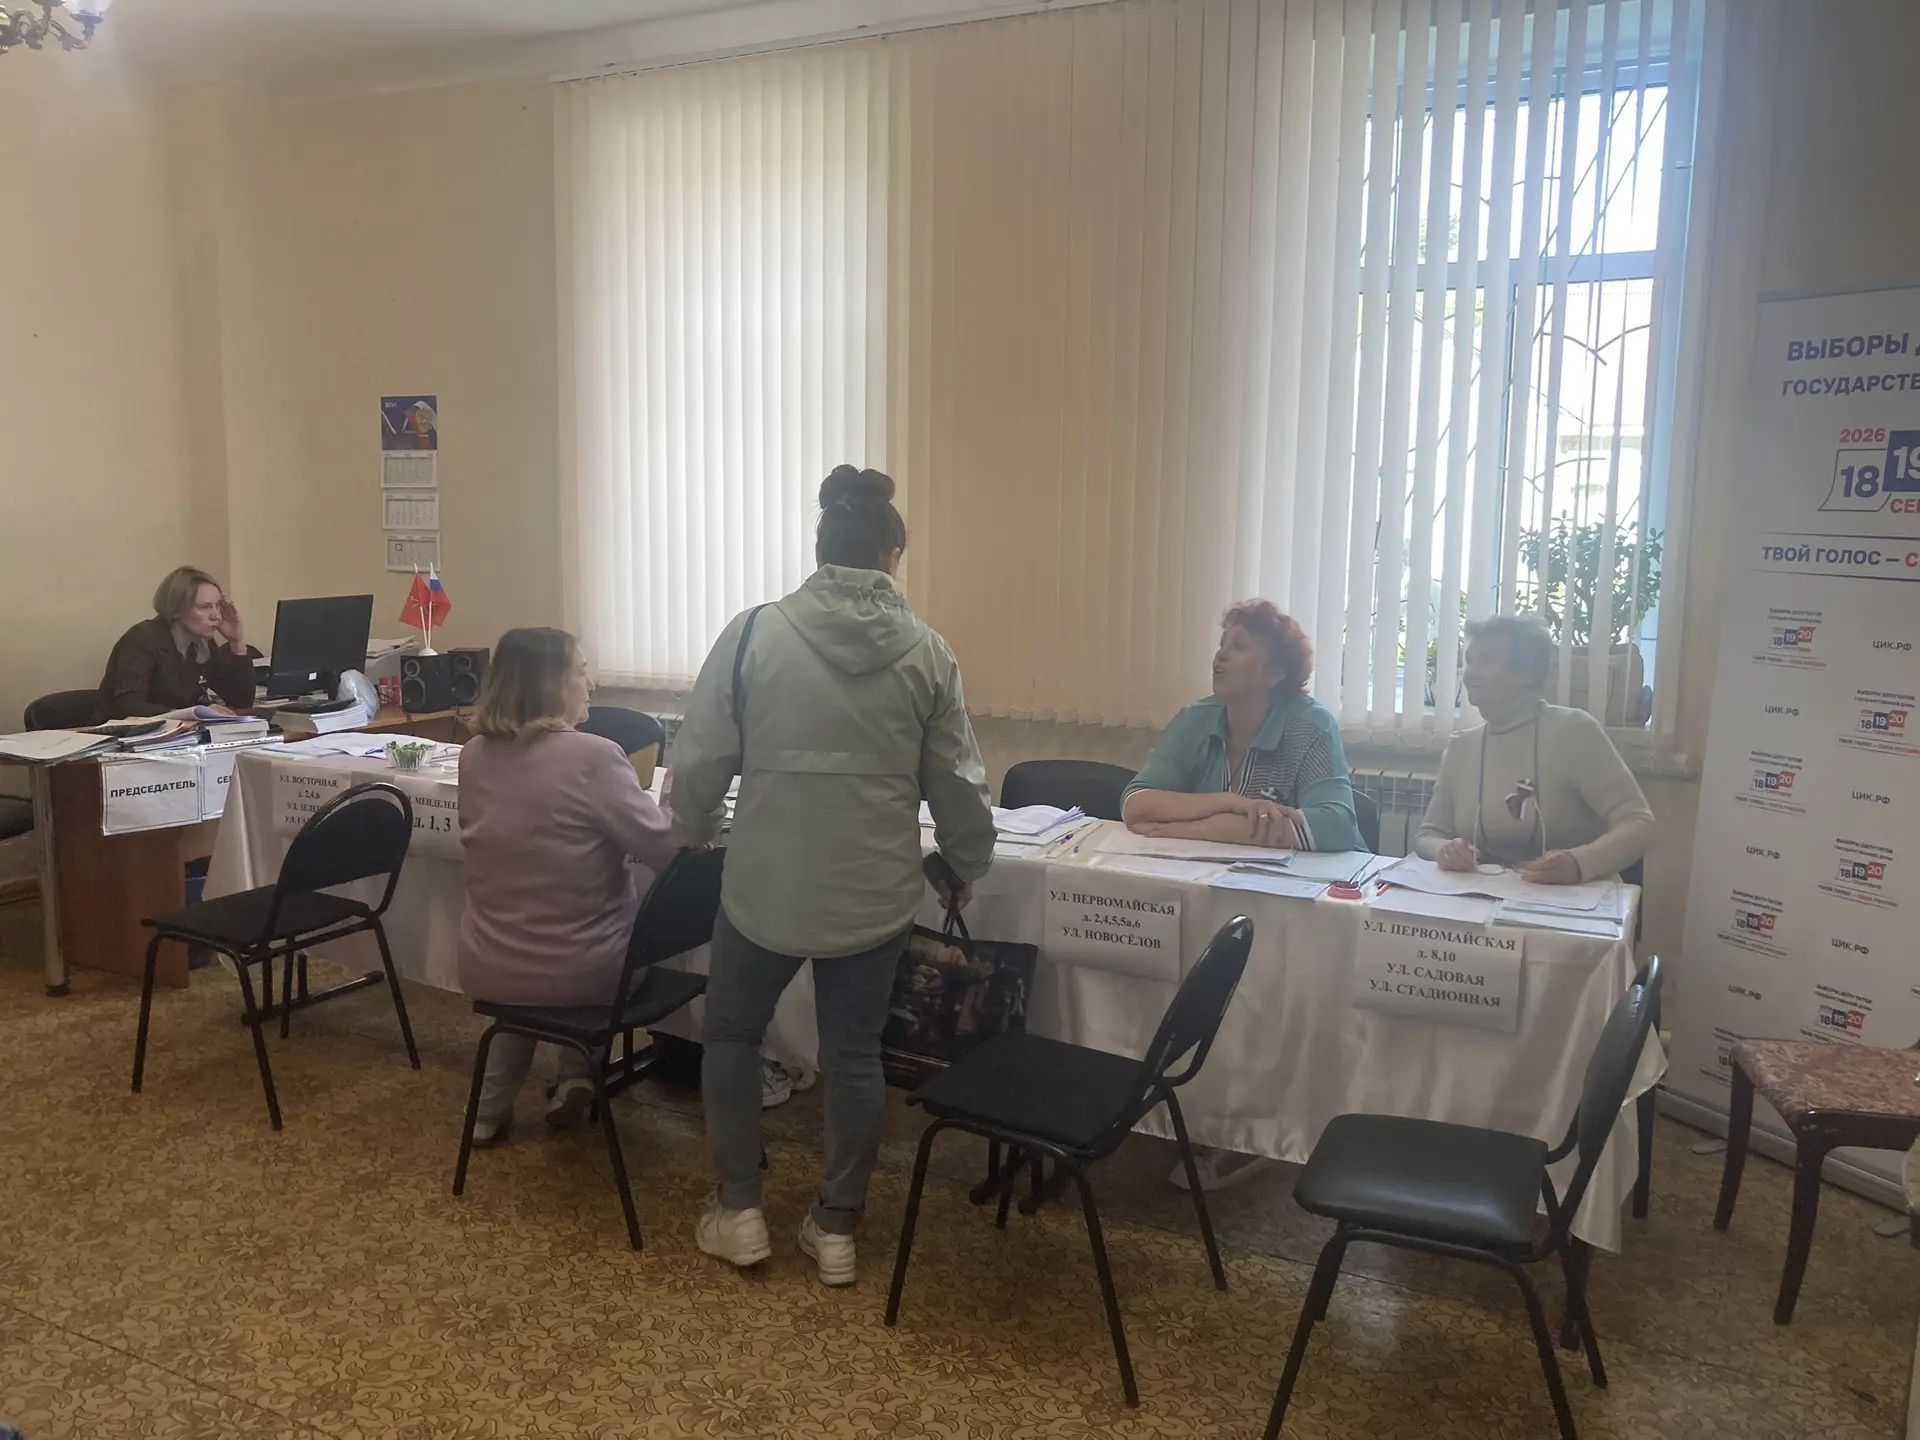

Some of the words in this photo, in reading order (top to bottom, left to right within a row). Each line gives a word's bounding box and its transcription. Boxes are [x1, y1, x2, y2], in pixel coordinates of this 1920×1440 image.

[1787, 332, 1909, 361] ВЫБОРЫ
[1840, 428, 1886, 443] 2026
[1840, 465, 1880, 498] 18
[1890, 498, 1920, 514] СЕ
[1761, 543, 1811, 562] ТВОЙ
[1815, 548, 1881, 566] ГОЛОС
[1772, 636, 1783, 646] 18
[1786, 633, 1797, 642] 19
[1797, 630, 1812, 639] 20
[1872, 640, 1912, 651] ЦИК.РФ
[1765, 704, 1800, 716] ЦИК.РФ
[1860, 719, 1872, 730] 18
[1875, 716, 1887, 727] 19
[1888, 713, 1904, 724] 20
[110, 780, 196, 798] ПРЕДСЕДАТЕЛЬ
[1852, 791, 1890, 804] ЦИК.РФ
[443, 817, 451, 832] 3
[1840, 868, 1851, 879] 18
[1853, 865, 1865, 877] 19
[1867, 864, 1882, 876] 20
[1050, 890, 1069, 902] УЛ.
[1072, 893, 1175, 916] ПЕРВОМАЙСКАЯ
[1063, 926, 1081, 938] УЛ.
[1085, 929, 1161, 949] НОВОСЁЛОВ
[1364, 920, 1386, 933] УЛ.
[1391, 923, 1515, 951] ПЕРВОМАЙСКАЯ
[1832, 938, 1869, 955] ЦИК.РФ
[1431, 950, 1456, 963] 8,10
[1387, 962, 1410, 976] УЛ.
[1414, 966, 1485, 987] САДОВАЯ
[1369, 979, 1392, 993] УЛ.
[1397, 984, 1501, 1008] СТАДИОННАЯ
